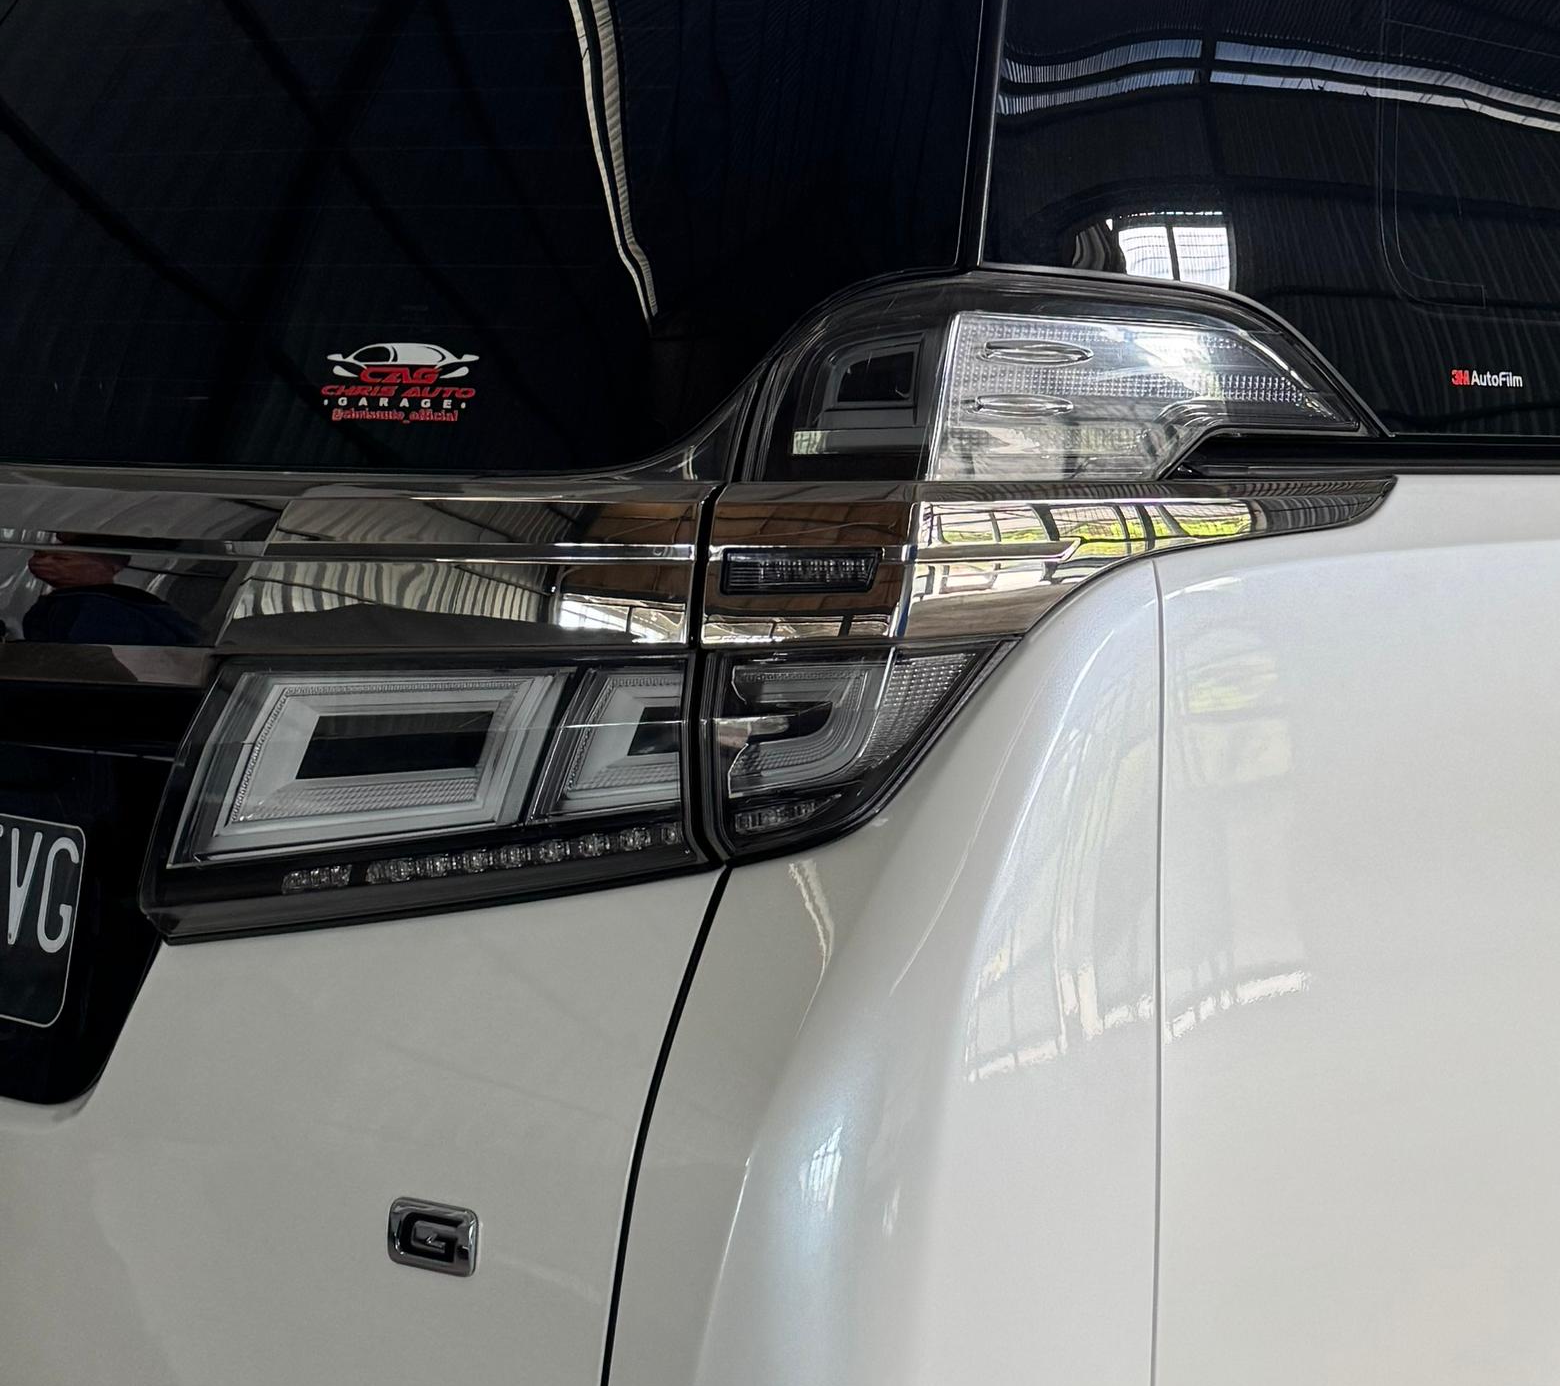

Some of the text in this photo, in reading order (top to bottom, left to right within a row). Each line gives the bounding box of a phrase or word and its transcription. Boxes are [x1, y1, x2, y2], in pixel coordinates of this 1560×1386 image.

[360, 366, 443, 384] CAG
[321, 385, 476, 399] CHRIS AUTO
[337, 397, 452, 409] GARAGE
[0, 824, 80, 953] VG
